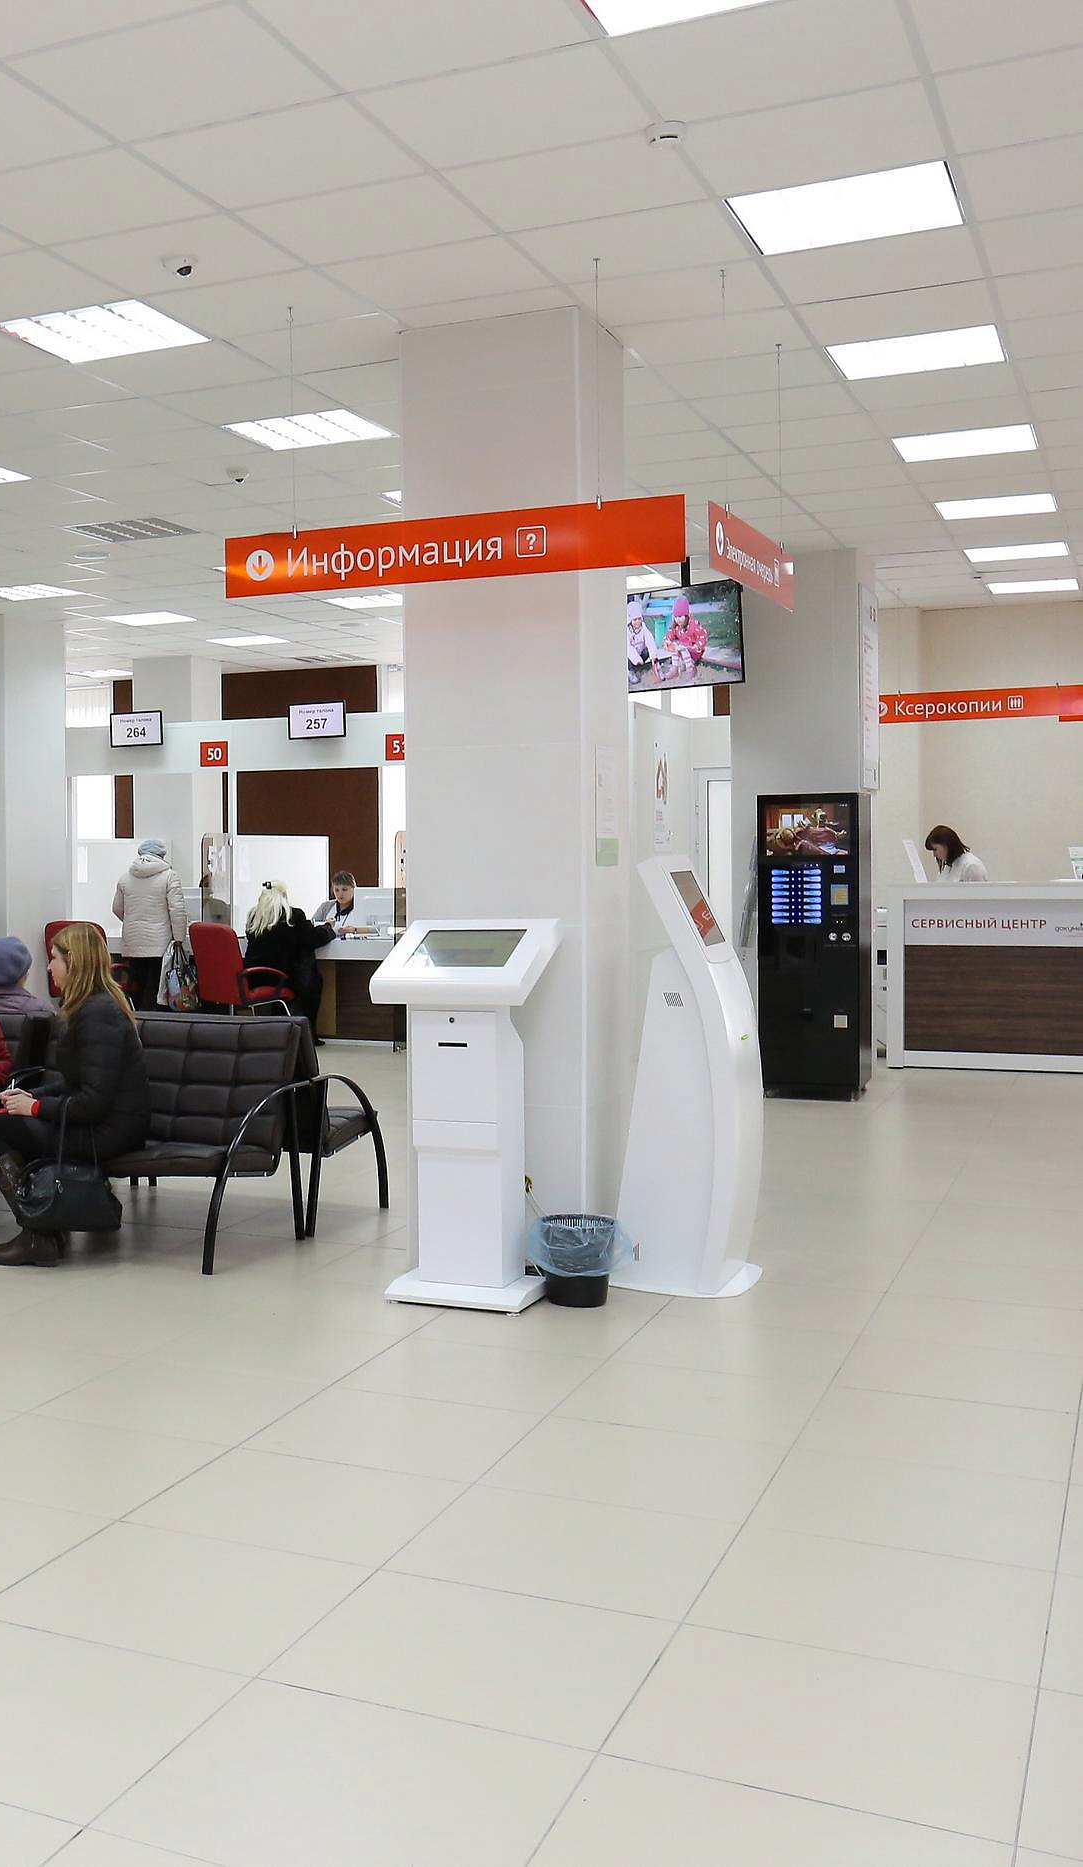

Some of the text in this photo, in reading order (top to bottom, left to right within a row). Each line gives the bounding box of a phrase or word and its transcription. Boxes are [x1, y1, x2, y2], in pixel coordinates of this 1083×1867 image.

[286, 535, 503, 580] Информация
[894, 699, 1003, 718] Ксерокопии
[305, 718, 328, 730] 257
[126, 726, 147, 738] 264
[207, 747, 222, 761] 50
[911, 917, 1047, 930] СЕРВИСНЫЙ ЦЕНТР
